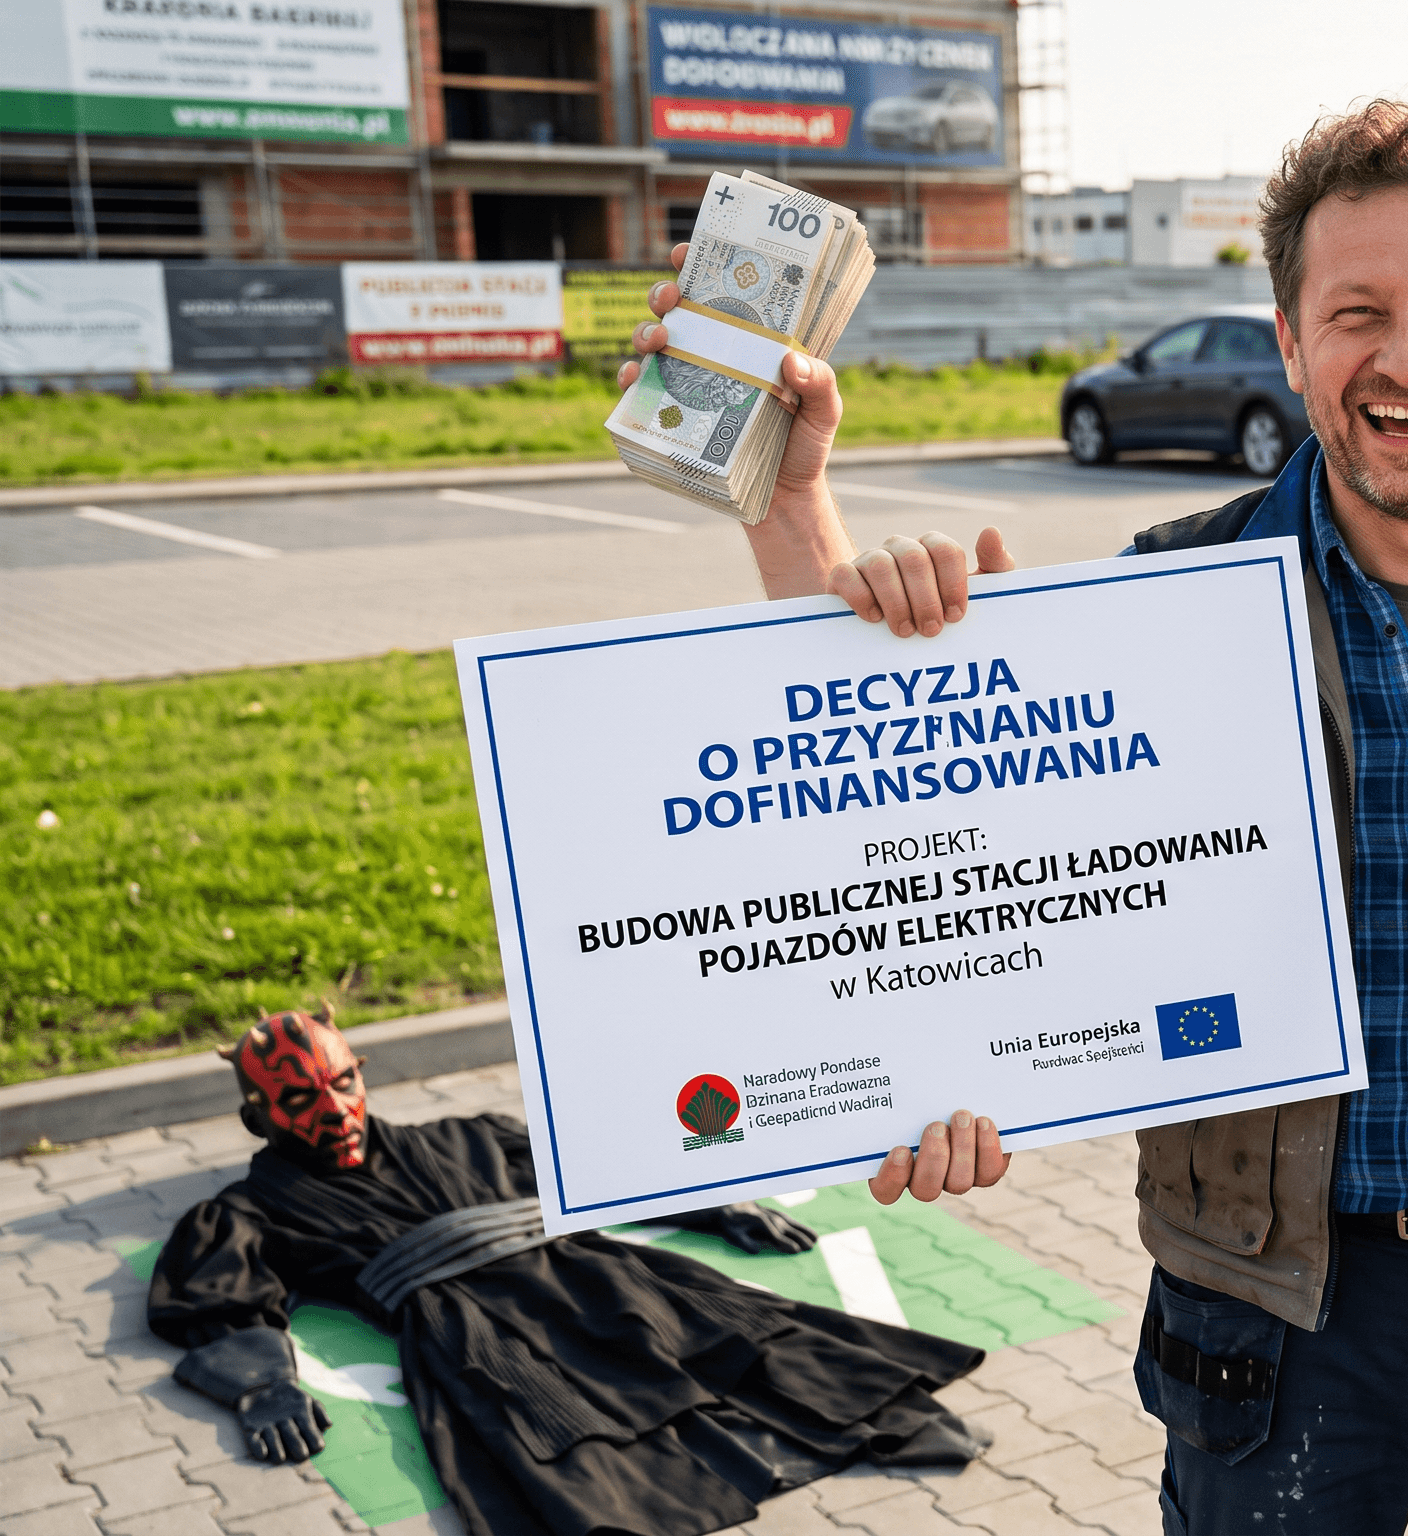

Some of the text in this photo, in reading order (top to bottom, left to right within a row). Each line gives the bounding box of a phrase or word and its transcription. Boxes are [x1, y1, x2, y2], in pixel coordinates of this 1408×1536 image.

[768, 202, 822, 240] 100
[785, 657, 1021, 722] DECYZJA
[663, 732, 1161, 836] DOFINANSOWANIA
[697, 743, 739, 781] O
[864, 827, 988, 867] PROJEKT:
[577, 824, 1268, 953] BUDOWA PUBLICZNEJ STACJI ŁADOWANIA
[698, 879, 1168, 978] POJAZDÓW ELEKTRYCZNYCH
[829, 941, 1044, 1000] w Katowicach
[989, 1019, 1141, 1057] Unia Europejska
[743, 1056, 881, 1088] Naradowy Pondase
